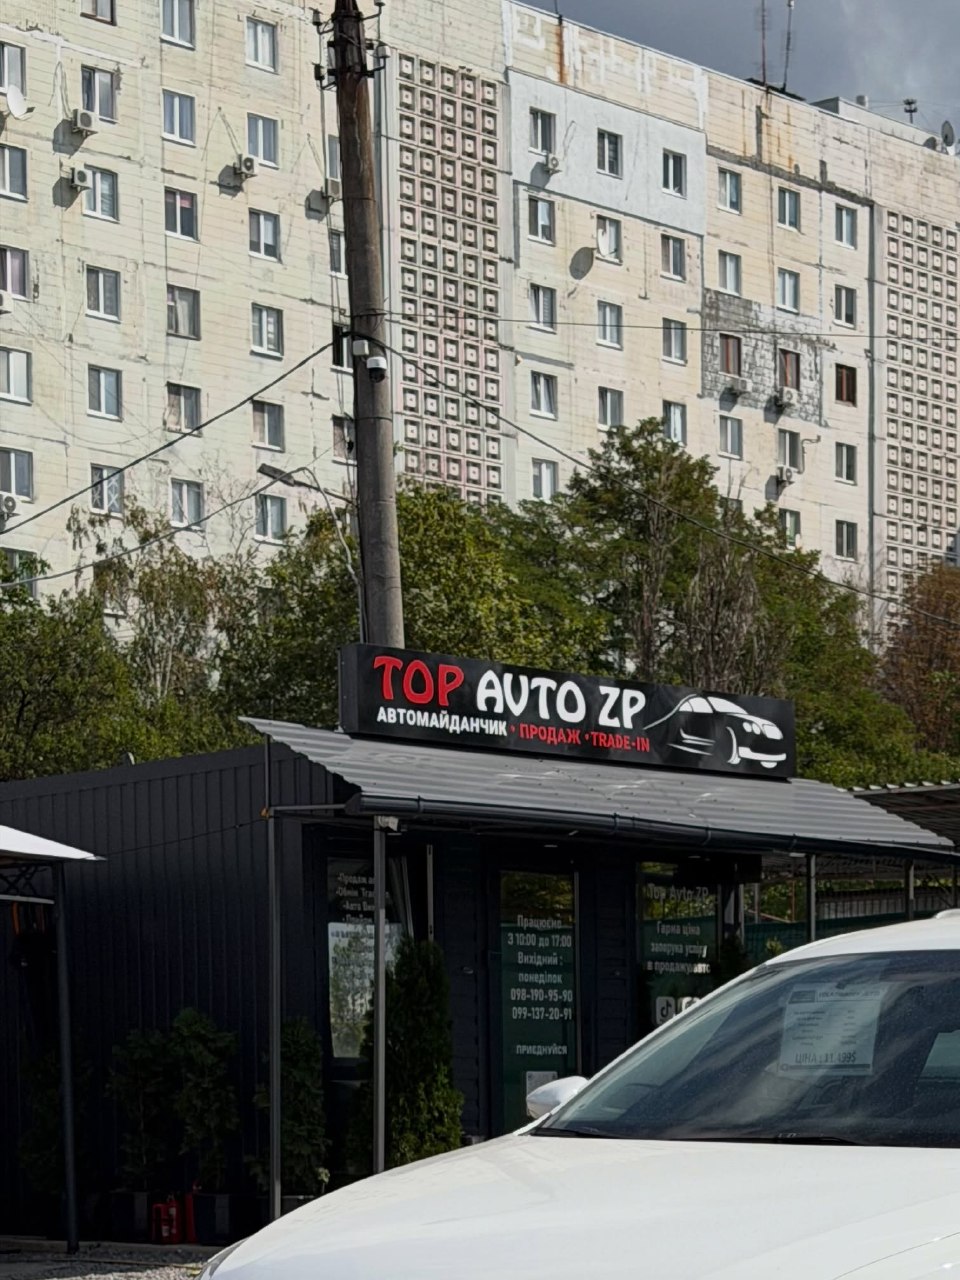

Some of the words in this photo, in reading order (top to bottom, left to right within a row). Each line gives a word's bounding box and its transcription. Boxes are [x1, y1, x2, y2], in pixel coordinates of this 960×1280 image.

[373, 655, 465, 707] TOP
[598, 685, 646, 729] ZP
[376, 705, 508, 737] АВТОМАЙДАНЧИК
[519, 723, 581, 745] ПРОДАЖ
[590, 731, 650, 753] TRADE-IN
[515, 933, 537, 946] 10:00
[538, 937, 550, 948] до
[551, 934, 572, 948] 17:00
[517, 951, 558, 966] Вихідний
[518, 970, 563, 985] понеділок
[510, 988, 574, 1003] 098-190-95-90
[512, 1006, 573, 1020] 099-137-20-91
